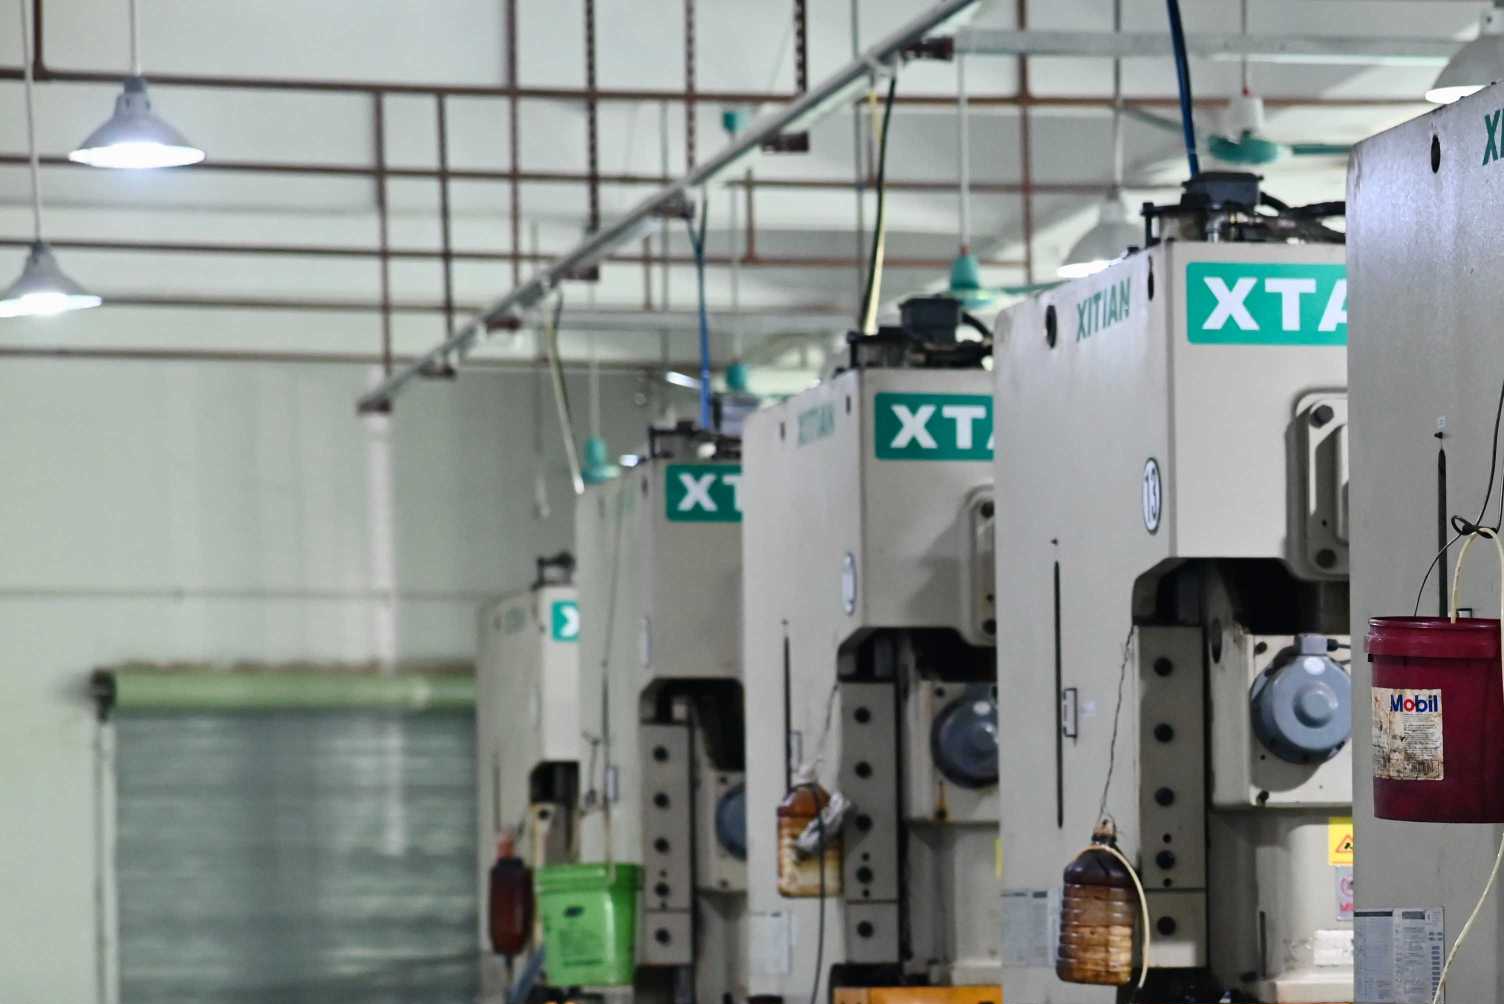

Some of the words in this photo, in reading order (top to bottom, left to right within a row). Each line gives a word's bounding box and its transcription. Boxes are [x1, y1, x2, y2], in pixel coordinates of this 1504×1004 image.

[1076, 277, 1131, 343] XITIAN
[890, 404, 995, 450] XT
[1390, 695, 1438, 713] Mobil
